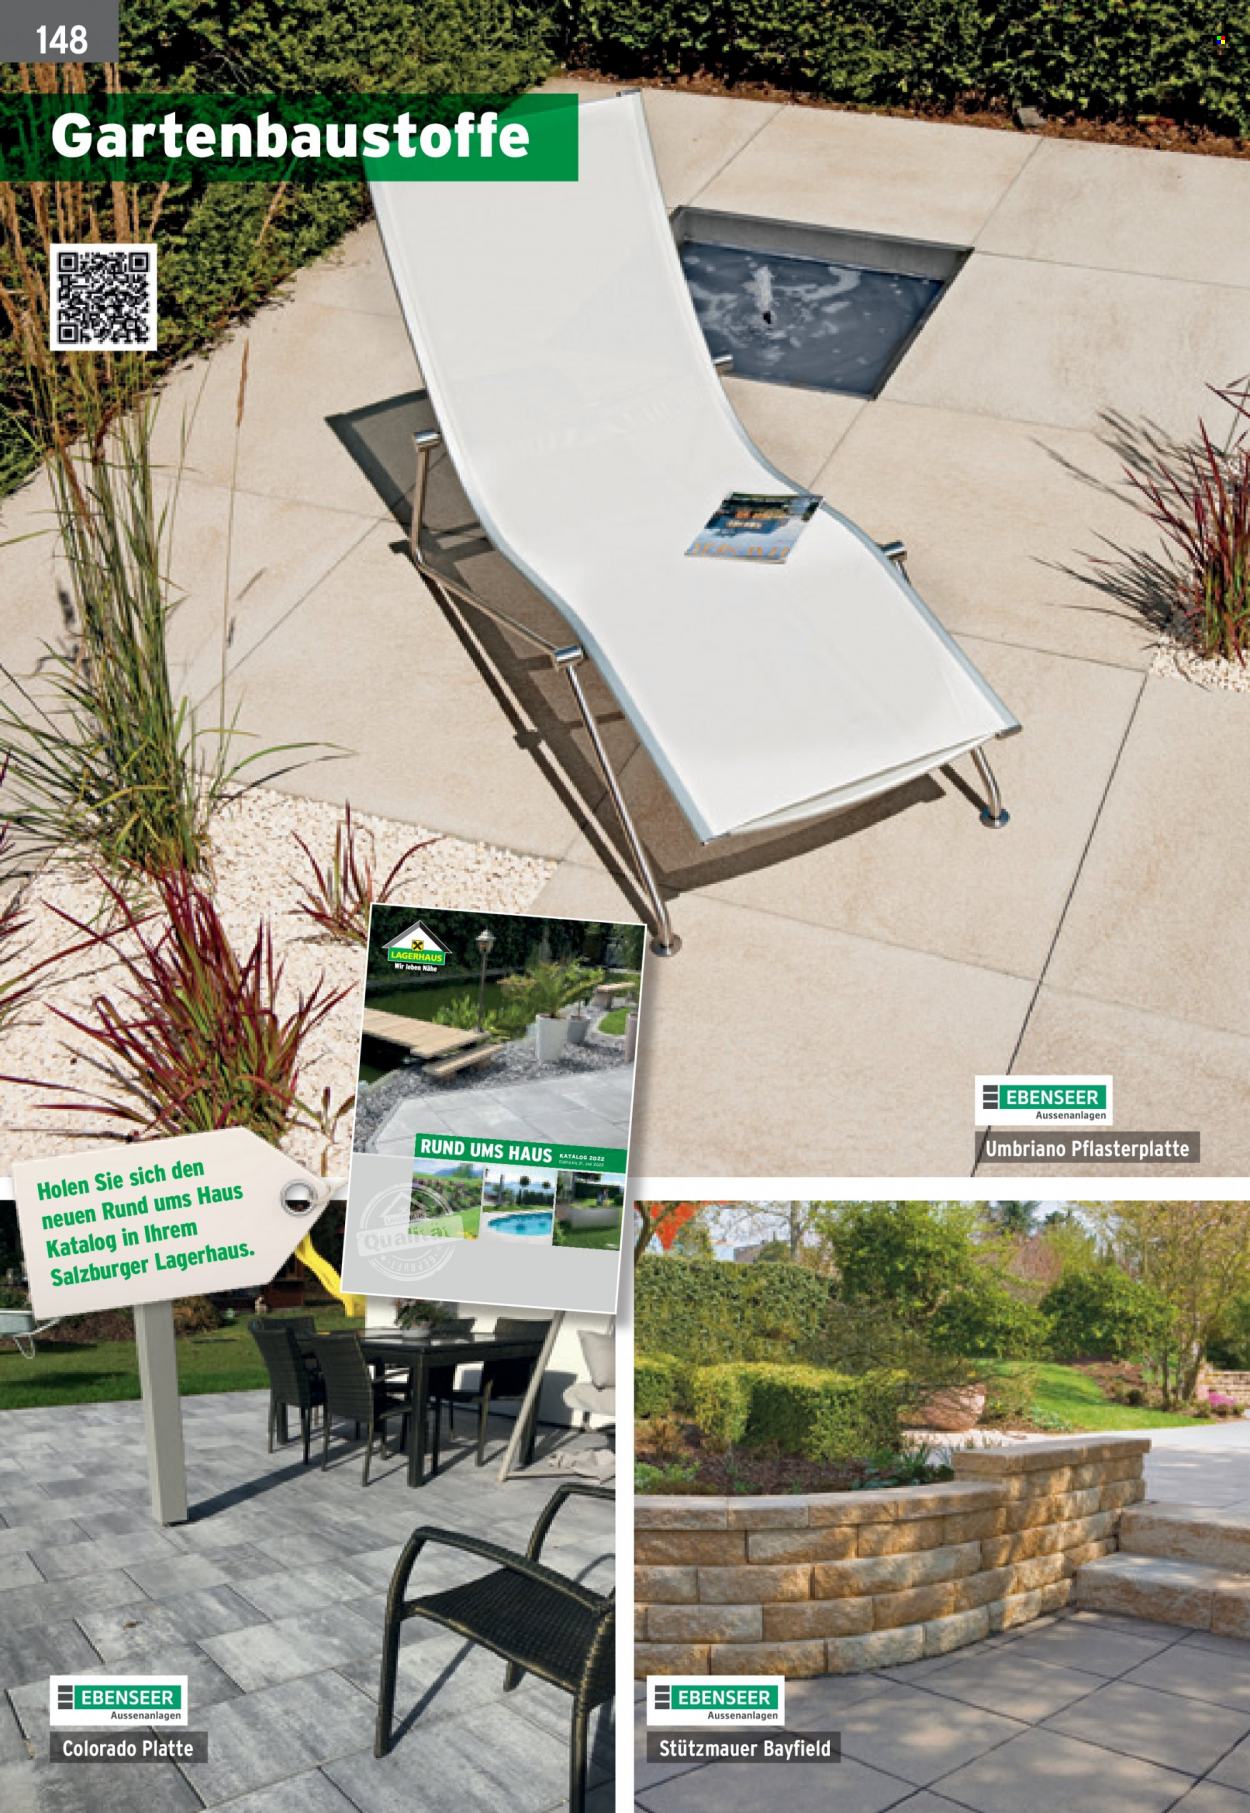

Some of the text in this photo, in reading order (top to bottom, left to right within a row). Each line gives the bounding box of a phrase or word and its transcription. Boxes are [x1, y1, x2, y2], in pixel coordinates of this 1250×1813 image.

[391, 951, 442, 961] LAGERHAUS
[421, 1139, 553, 1163] RUND UMS HAUS
